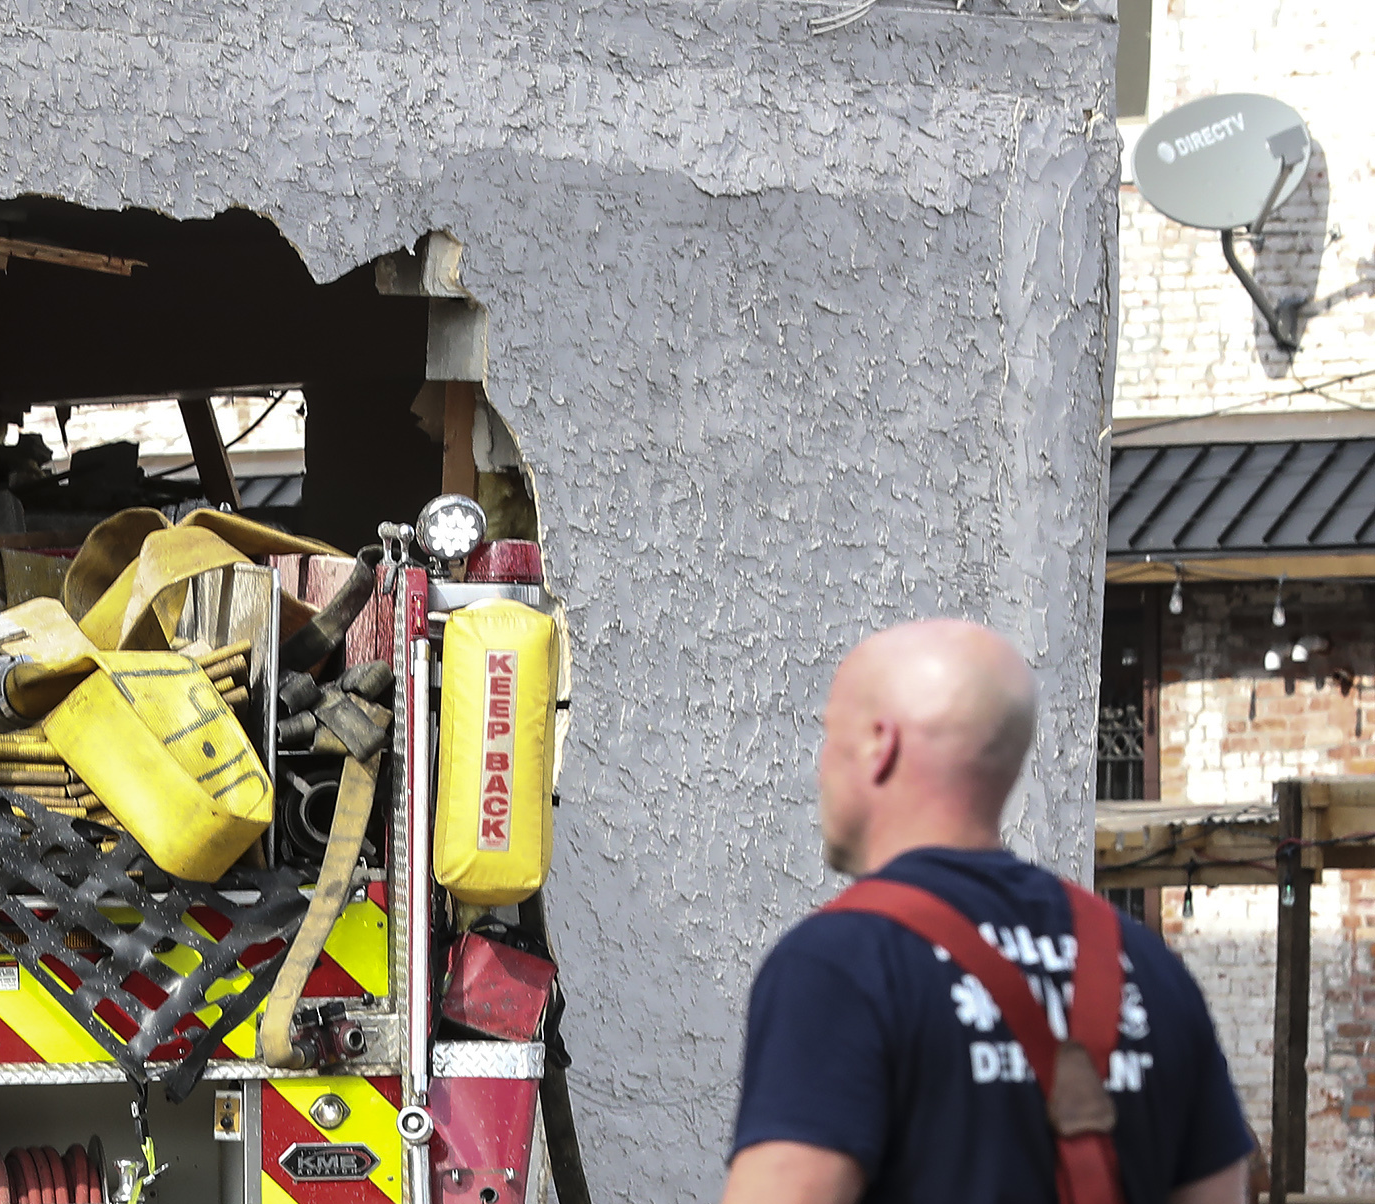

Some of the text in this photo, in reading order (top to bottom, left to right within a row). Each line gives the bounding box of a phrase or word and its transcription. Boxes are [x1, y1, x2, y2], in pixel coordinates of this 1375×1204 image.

[1174, 112, 1246, 157] DIRECTV
[487, 653, 513, 740] KEEP
[481, 751, 510, 839] BACK
[297, 1154, 358, 1169] KME
